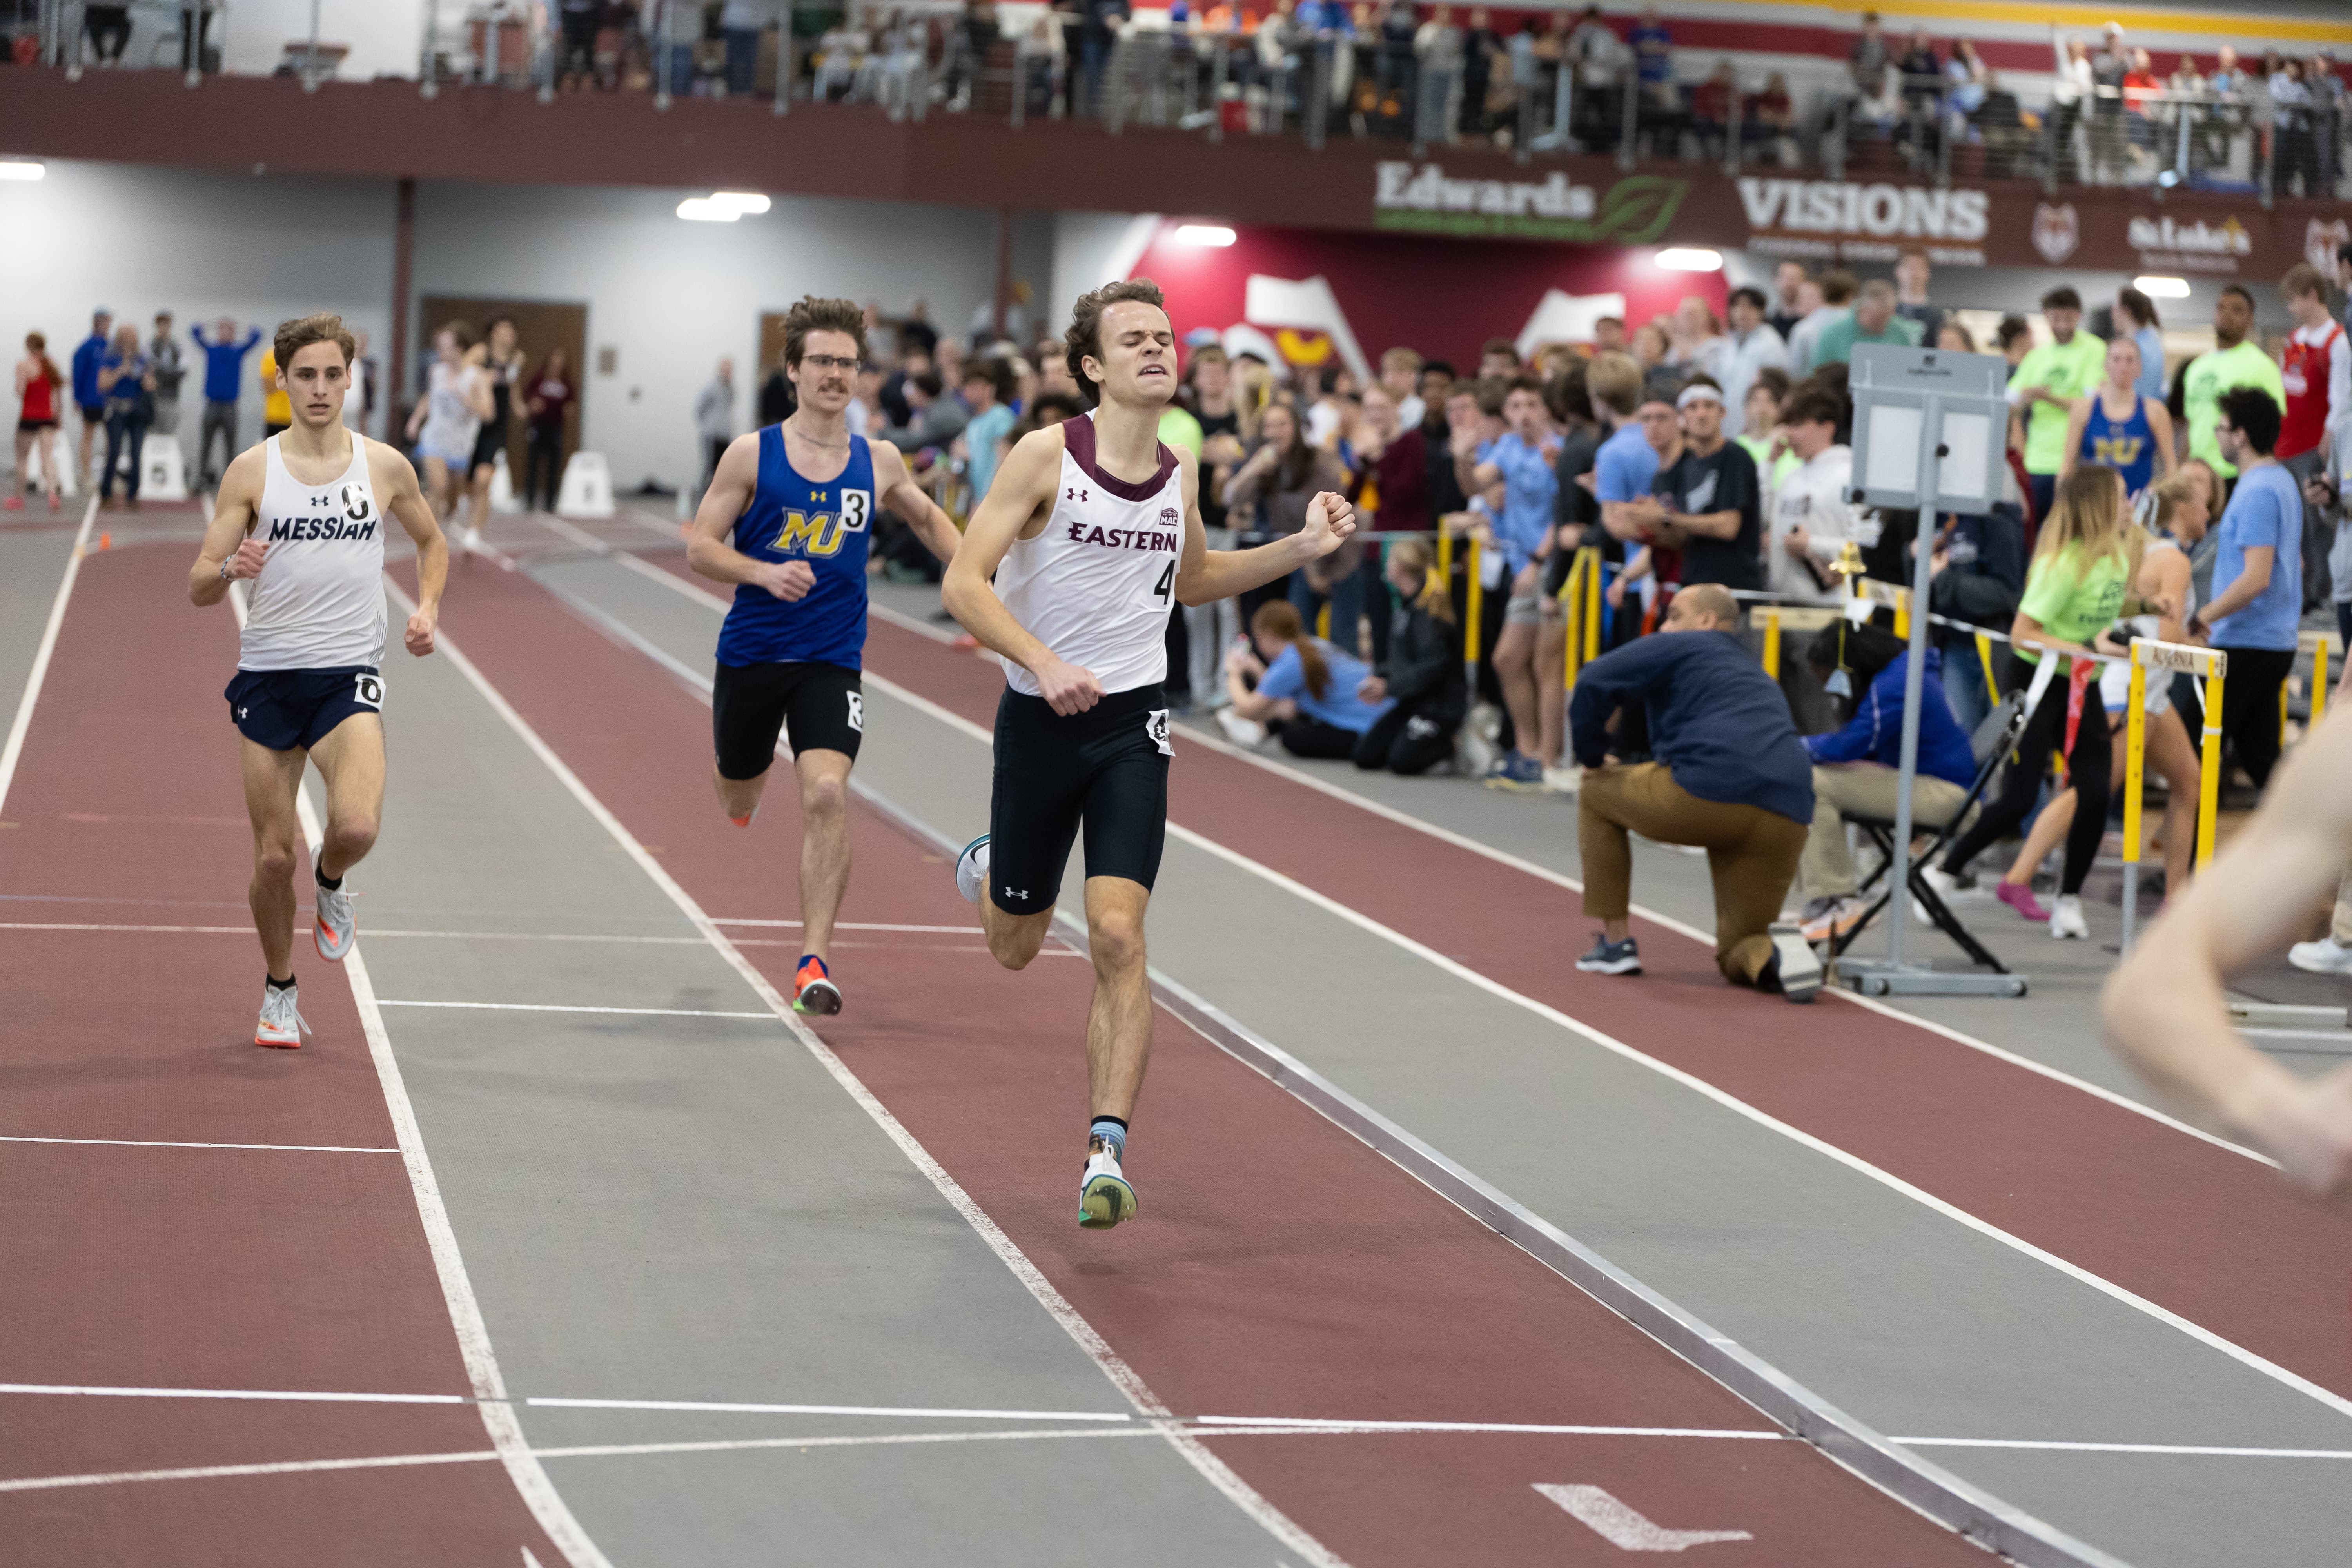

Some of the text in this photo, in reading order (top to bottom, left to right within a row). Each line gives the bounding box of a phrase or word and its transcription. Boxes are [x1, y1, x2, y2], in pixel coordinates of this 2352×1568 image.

[1375, 161, 1596, 219] Edwards
[1739, 177, 1990, 241] VISIONS
[269, 518, 377, 541] MESSIAH
[845, 494, 863, 528] 3
[1160, 516, 1177, 525] MAC
[767, 507, 845, 559] MU
[1068, 521, 1176, 552] EASTERN
[1153, 559, 1175, 605] 4
